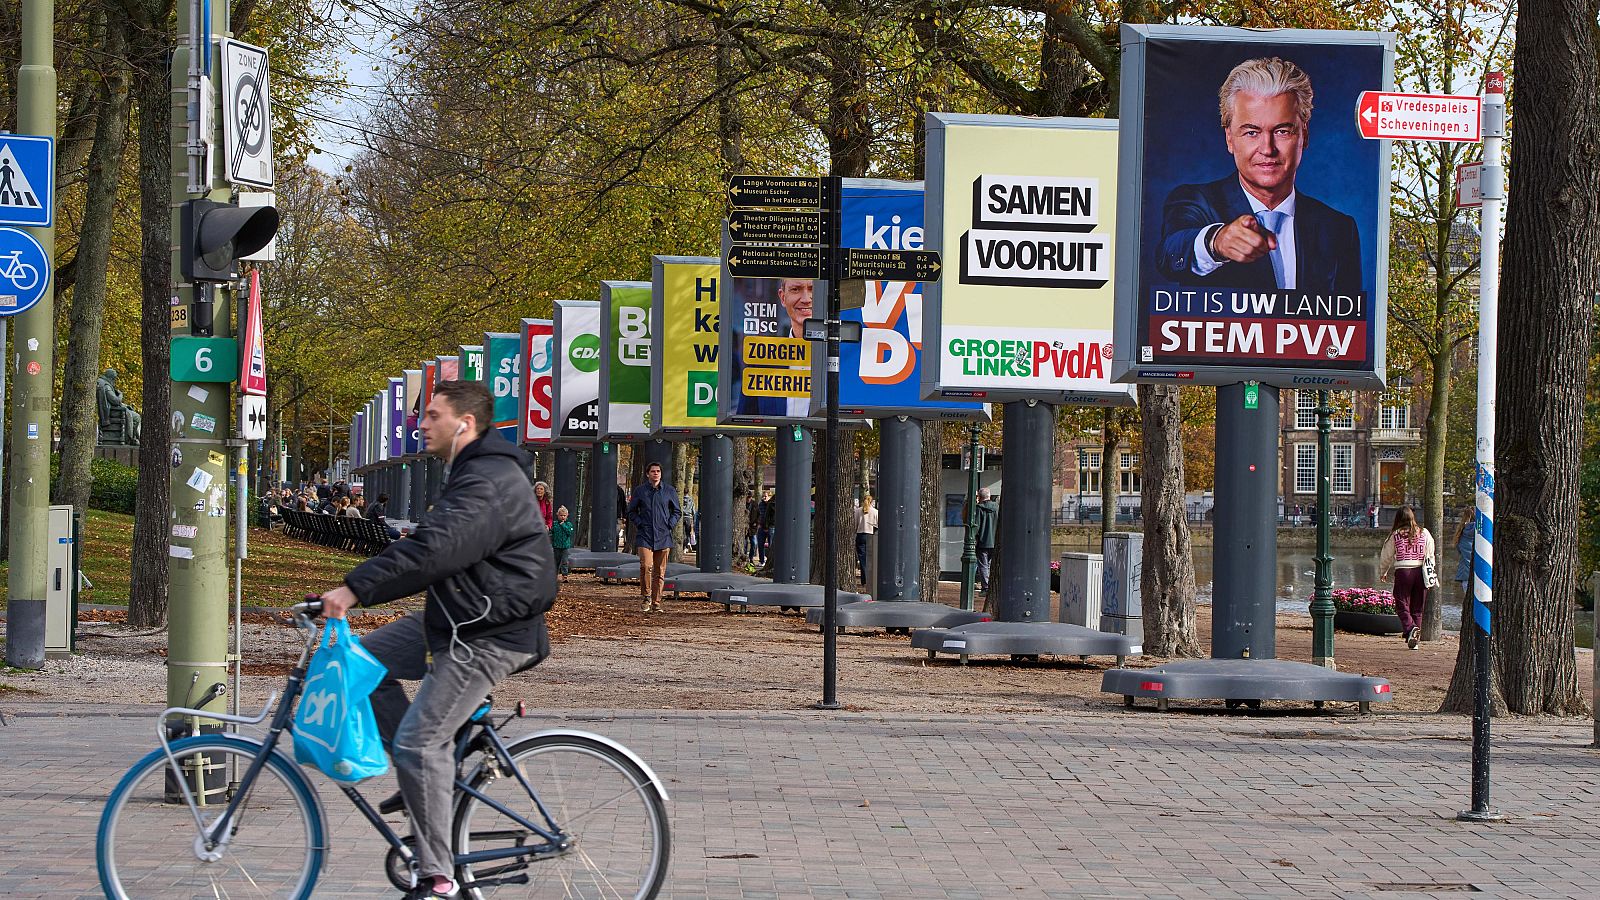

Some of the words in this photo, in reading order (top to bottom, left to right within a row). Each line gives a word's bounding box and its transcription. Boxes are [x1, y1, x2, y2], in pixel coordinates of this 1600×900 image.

[238, 53, 257, 70] ZONE
[240, 98, 260, 132] 30
[1396, 99, 1468, 115] Vredespaleis
[1380, 118, 1460, 135] Scheveningen
[1463, 123, 1469, 133] 3
[743, 180, 764, 188] Lange
[987, 183, 1092, 217] SAMEN
[743, 214, 768, 222] Theater
[769, 215, 800, 223] Diligentia
[743, 222, 771, 230] Theater
[865, 214, 924, 250] kie
[851, 261, 897, 269] Mauritshuis
[852, 252, 890, 260] Binnenhof
[974, 239, 1103, 272] VOORUIT
[743, 302, 777, 318] STEM
[1155, 290, 1197, 313] DIT
[1203, 292, 1223, 314] IS
[1231, 293, 1277, 315] UW
[1284, 295, 1362, 317] LAND!
[618, 306, 651, 339] B
[1161, 320, 1265, 354] STEM
[1276, 323, 1356, 356] PVV
[624, 344, 651, 360] LE
[748, 342, 806, 361] ZORGEN
[948, 338, 1032, 359] GROEN
[195, 347, 213, 373] 6
[962, 357, 1031, 378] LINKS
[1032, 341, 1104, 379] PvdA
[747, 374, 811, 392] ZEKERHE
[1292, 375, 1350, 386] trotter.eu
[694, 382, 718, 405] D
